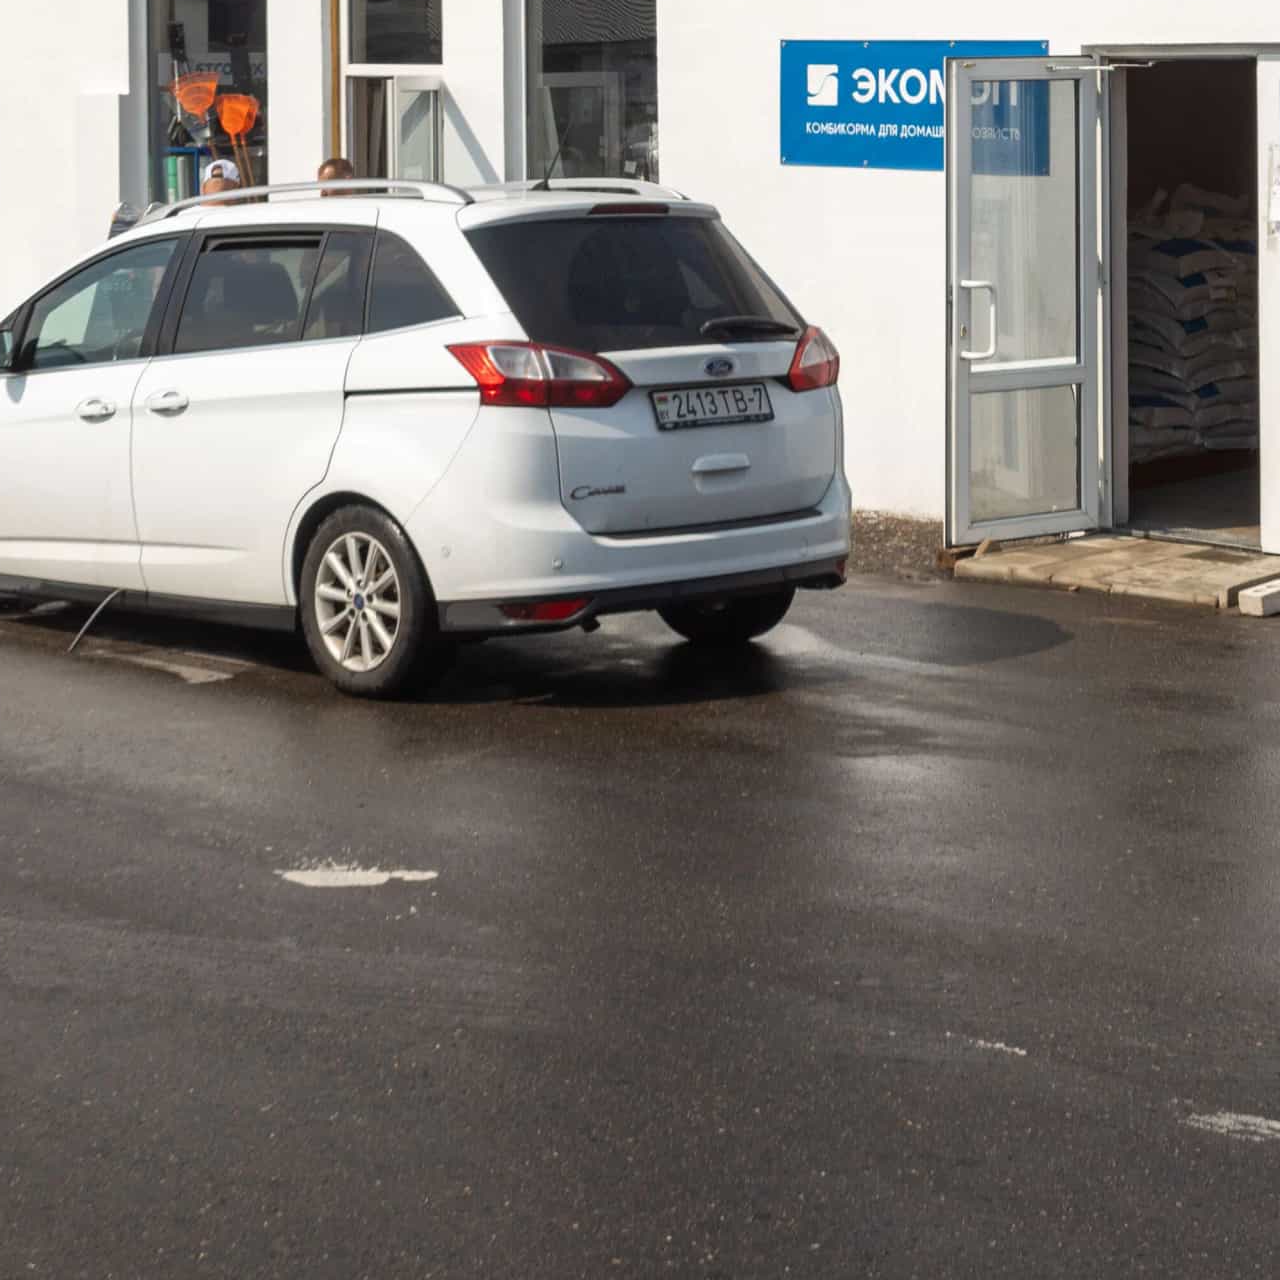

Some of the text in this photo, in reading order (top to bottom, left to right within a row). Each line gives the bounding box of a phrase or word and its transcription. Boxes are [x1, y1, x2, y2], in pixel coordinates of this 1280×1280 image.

[851, 67, 1018, 107] ЭКОЛ
[805, 122, 1021, 141] КОМБИКОРМА ДЛЯ ДОМАШ ОЗЯЙСТВ
